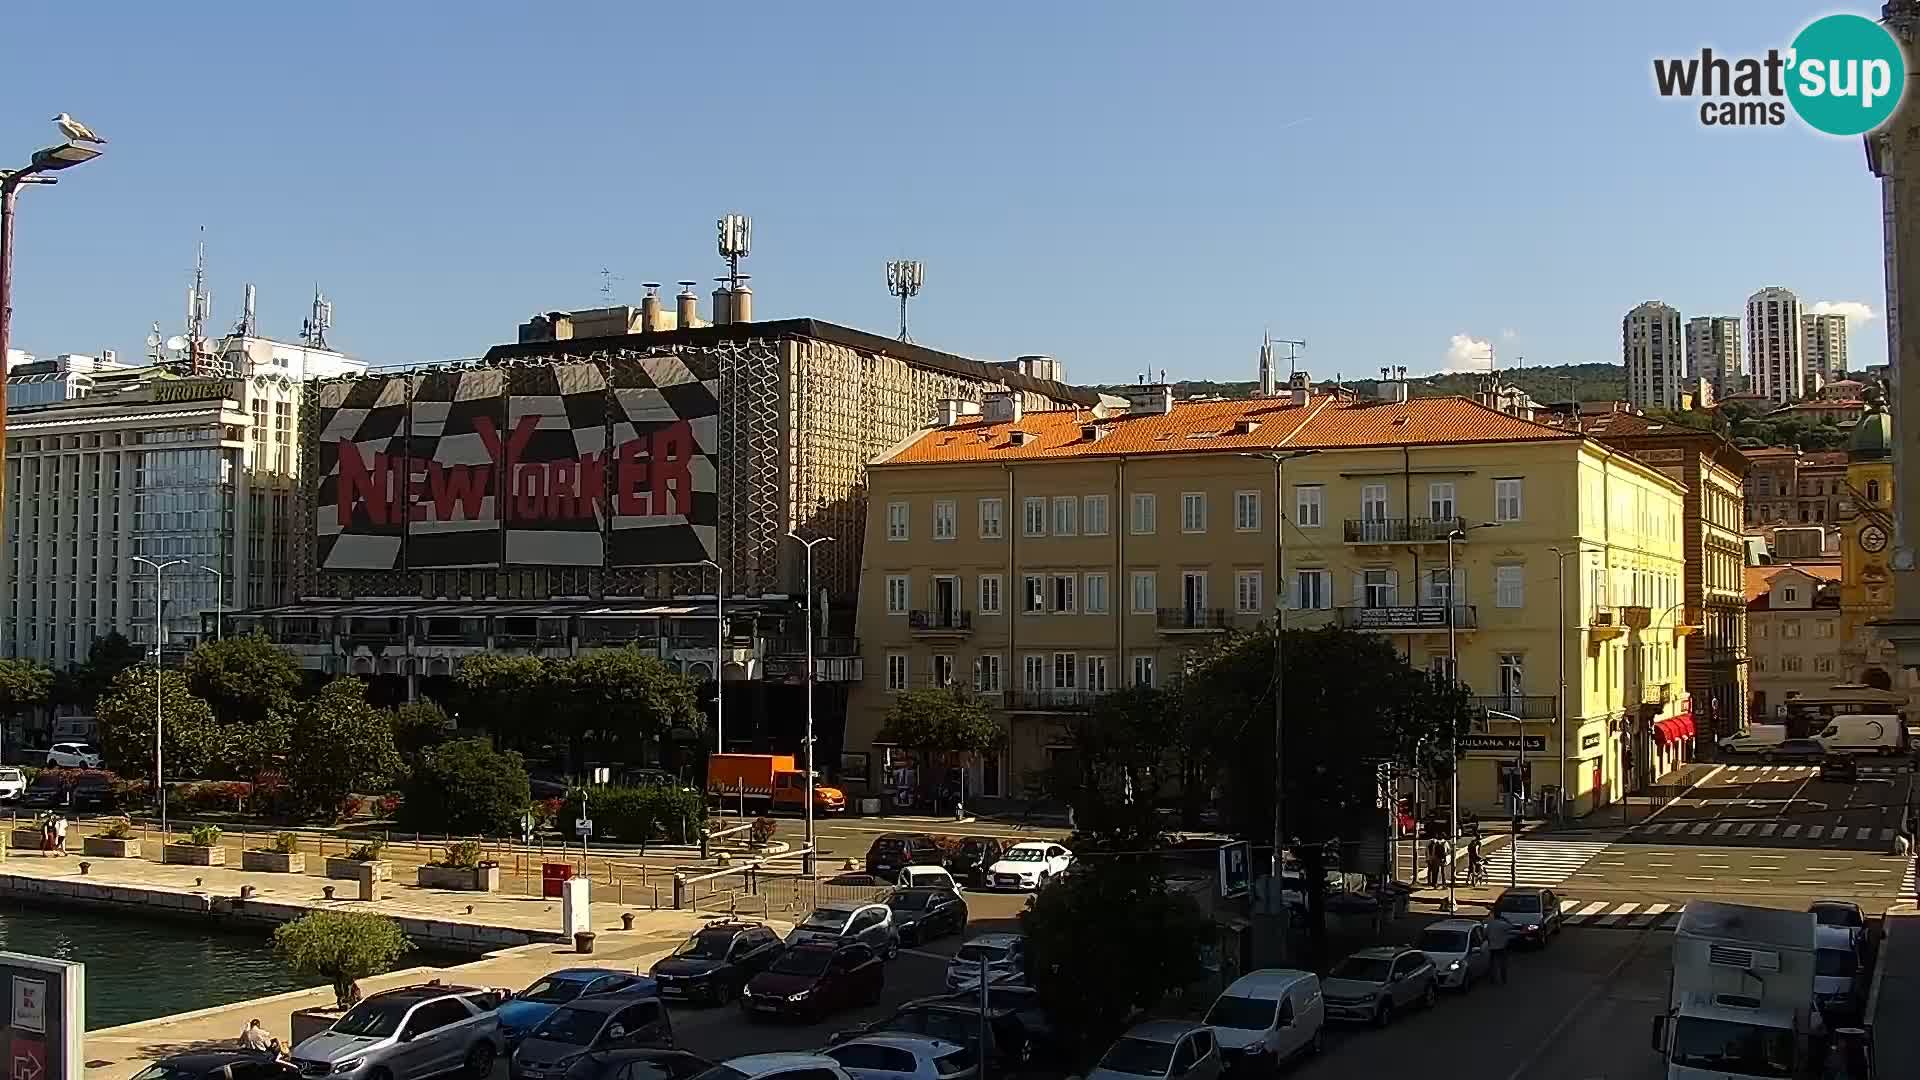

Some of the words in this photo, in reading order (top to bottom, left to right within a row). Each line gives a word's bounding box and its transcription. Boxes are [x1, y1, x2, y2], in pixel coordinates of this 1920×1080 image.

[337, 435, 491, 528] NEW
[472, 414, 693, 521] YORKER
[1458, 739, 1504, 747] JULIANA
